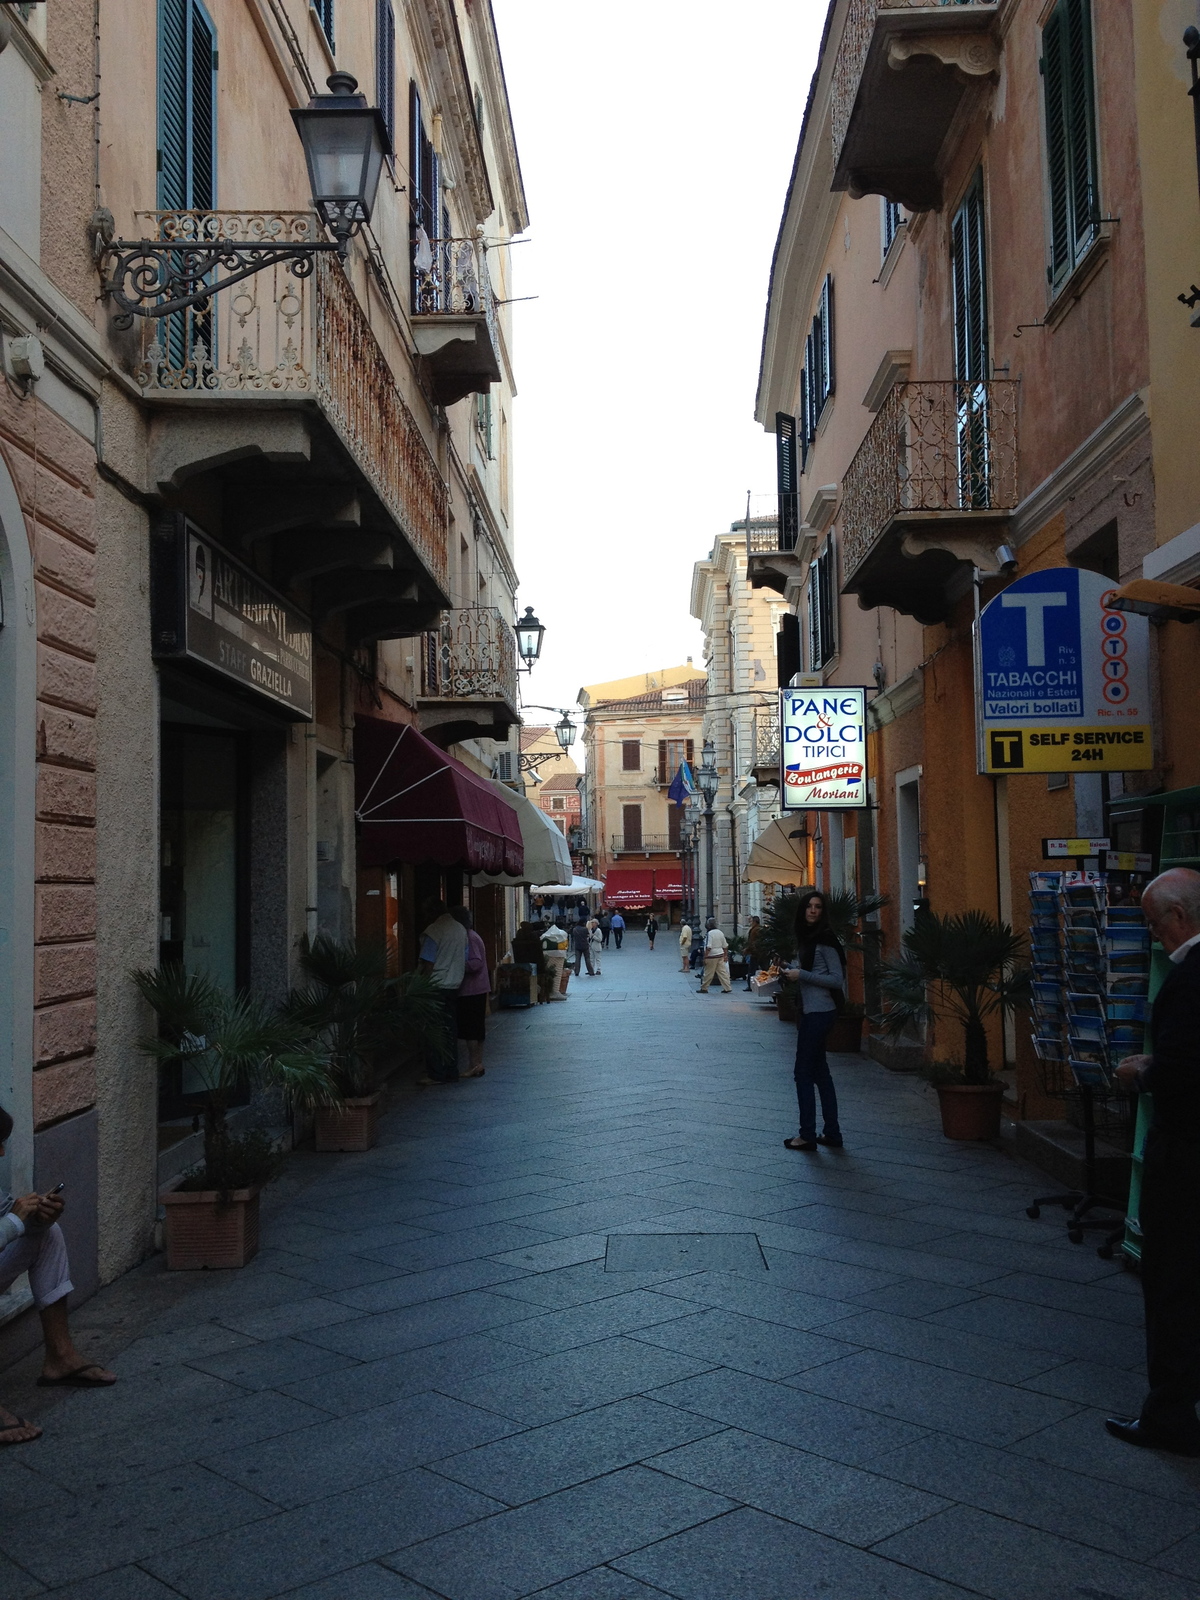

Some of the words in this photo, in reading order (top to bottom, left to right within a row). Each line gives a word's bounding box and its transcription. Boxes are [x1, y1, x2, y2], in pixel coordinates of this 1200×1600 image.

[213, 557, 241, 612] ART
[1001, 591, 1068, 667] T
[219, 640, 247, 672] STAFF
[1058, 645, 1076, 654] Riv.
[1070, 656, 1076, 665] 3
[250, 657, 293, 697] GRAZIELLA
[986, 670, 1077, 687] TABACCHI
[987, 688, 1035, 698] Nazionali
[1047, 687, 1077, 697] Esteri
[791, 698, 858, 716] PANE
[988, 702, 1029, 715] Valori
[1033, 701, 1078, 714] bollati
[1097, 708, 1114, 717] Ric.
[816, 712, 834, 729] &
[785, 725, 864, 743] DOLCI
[1029, 733, 1070, 746] SELF
[1073, 731, 1144, 746] SERVICE
[802, 745, 846, 758] TIPICI
[994, 736, 1019, 763] T
[1071, 749, 1104, 762] 24H
[787, 763, 859, 785] Boulangerie
[805, 787, 859, 802] Moriani
